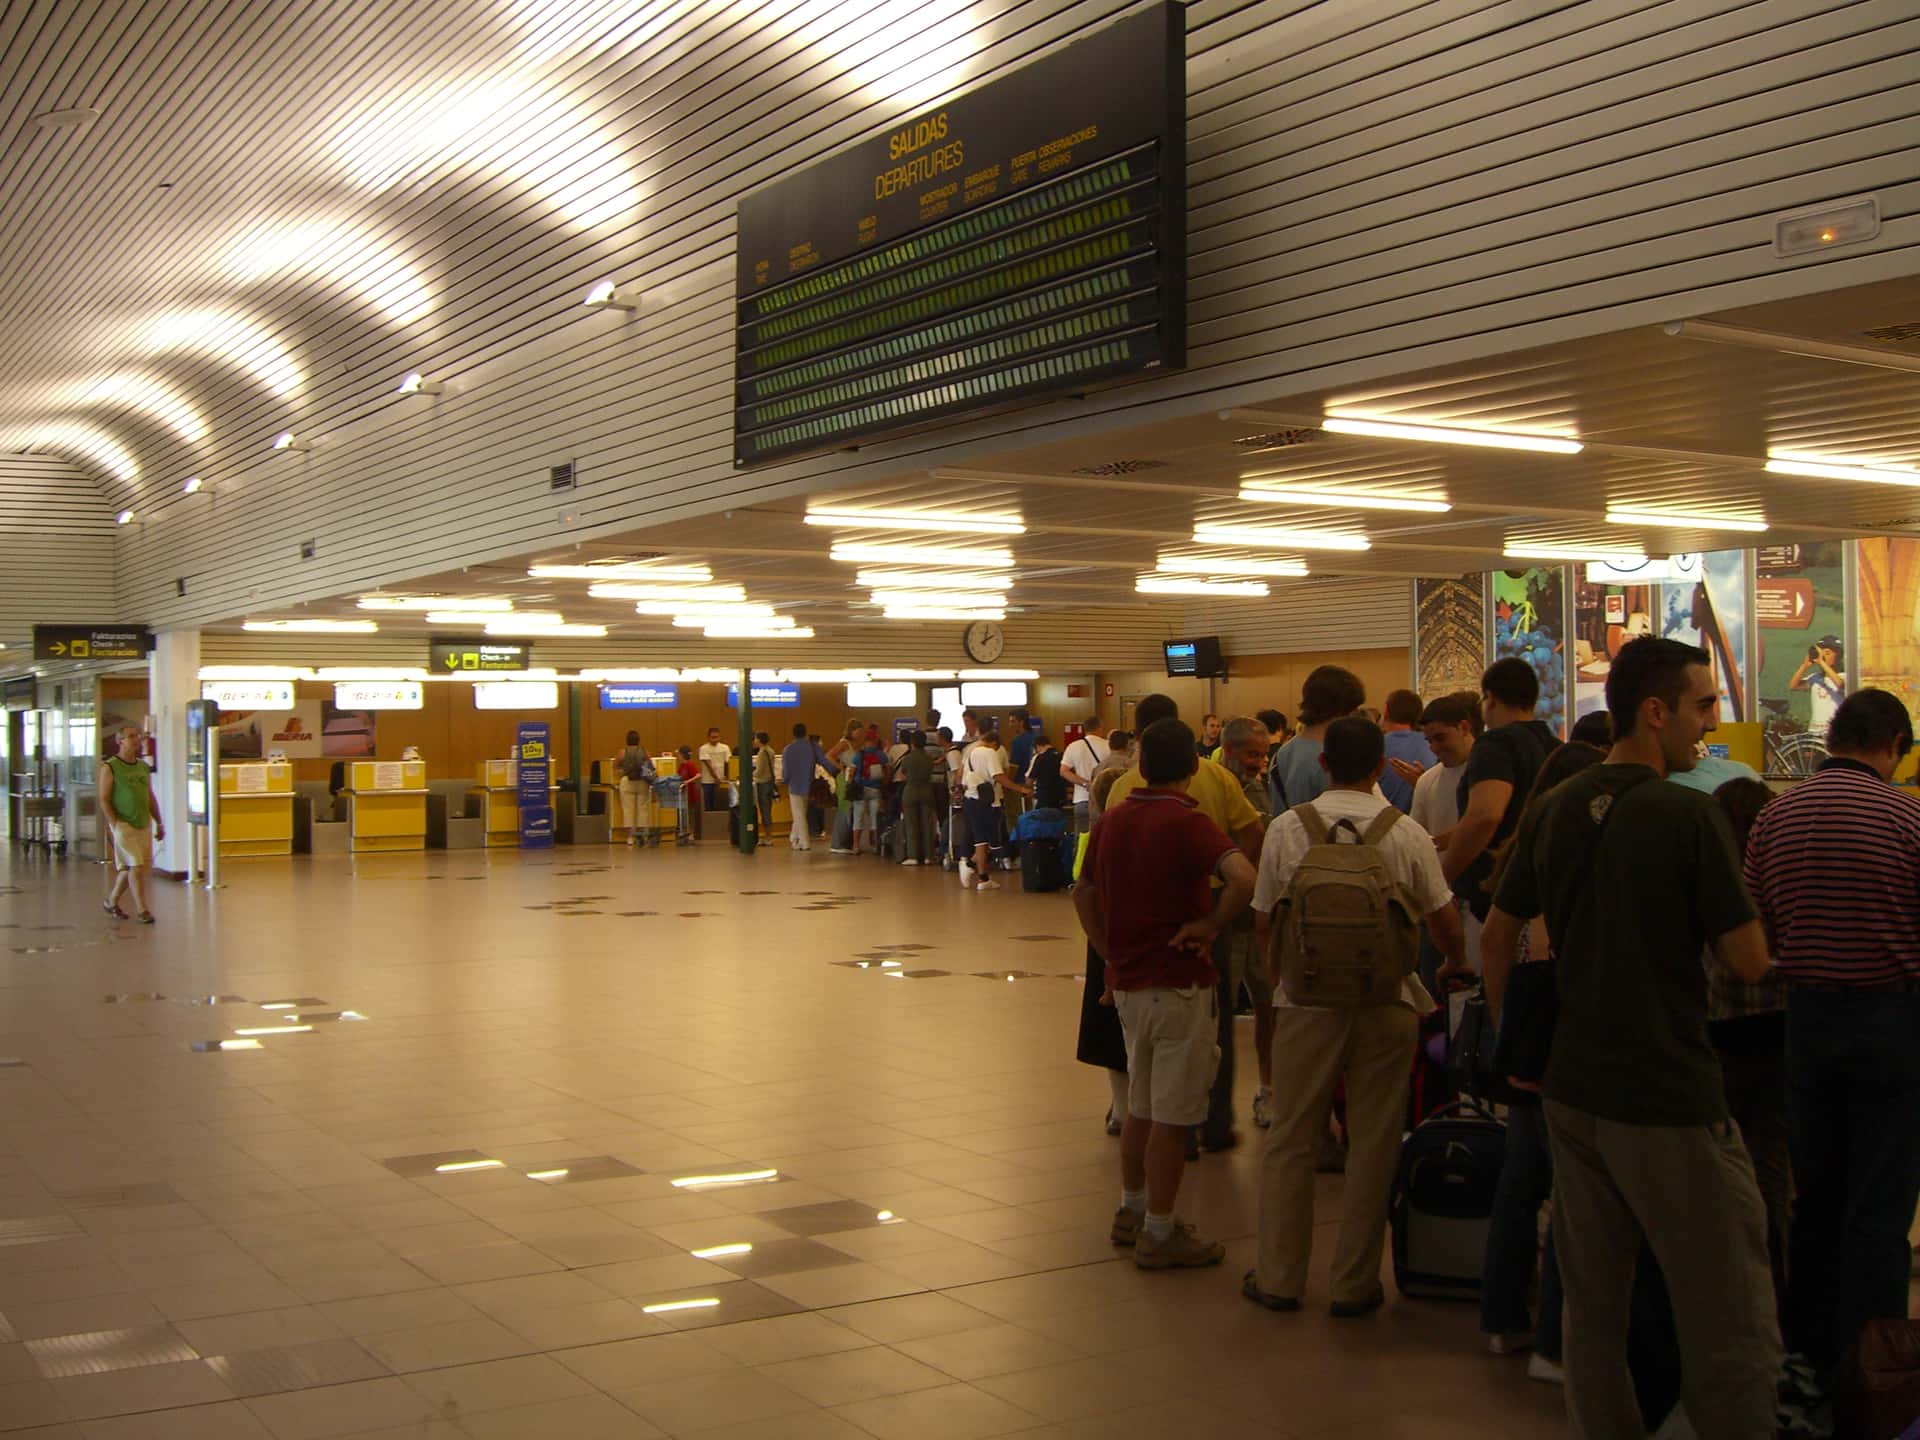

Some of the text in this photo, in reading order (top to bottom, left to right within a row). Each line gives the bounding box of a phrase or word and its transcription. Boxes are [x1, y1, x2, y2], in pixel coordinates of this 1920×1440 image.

[889, 112, 948, 160] SALIDAS
[875, 140, 964, 200] DEPARTURES
[272, 733, 312, 742] IBERIA
